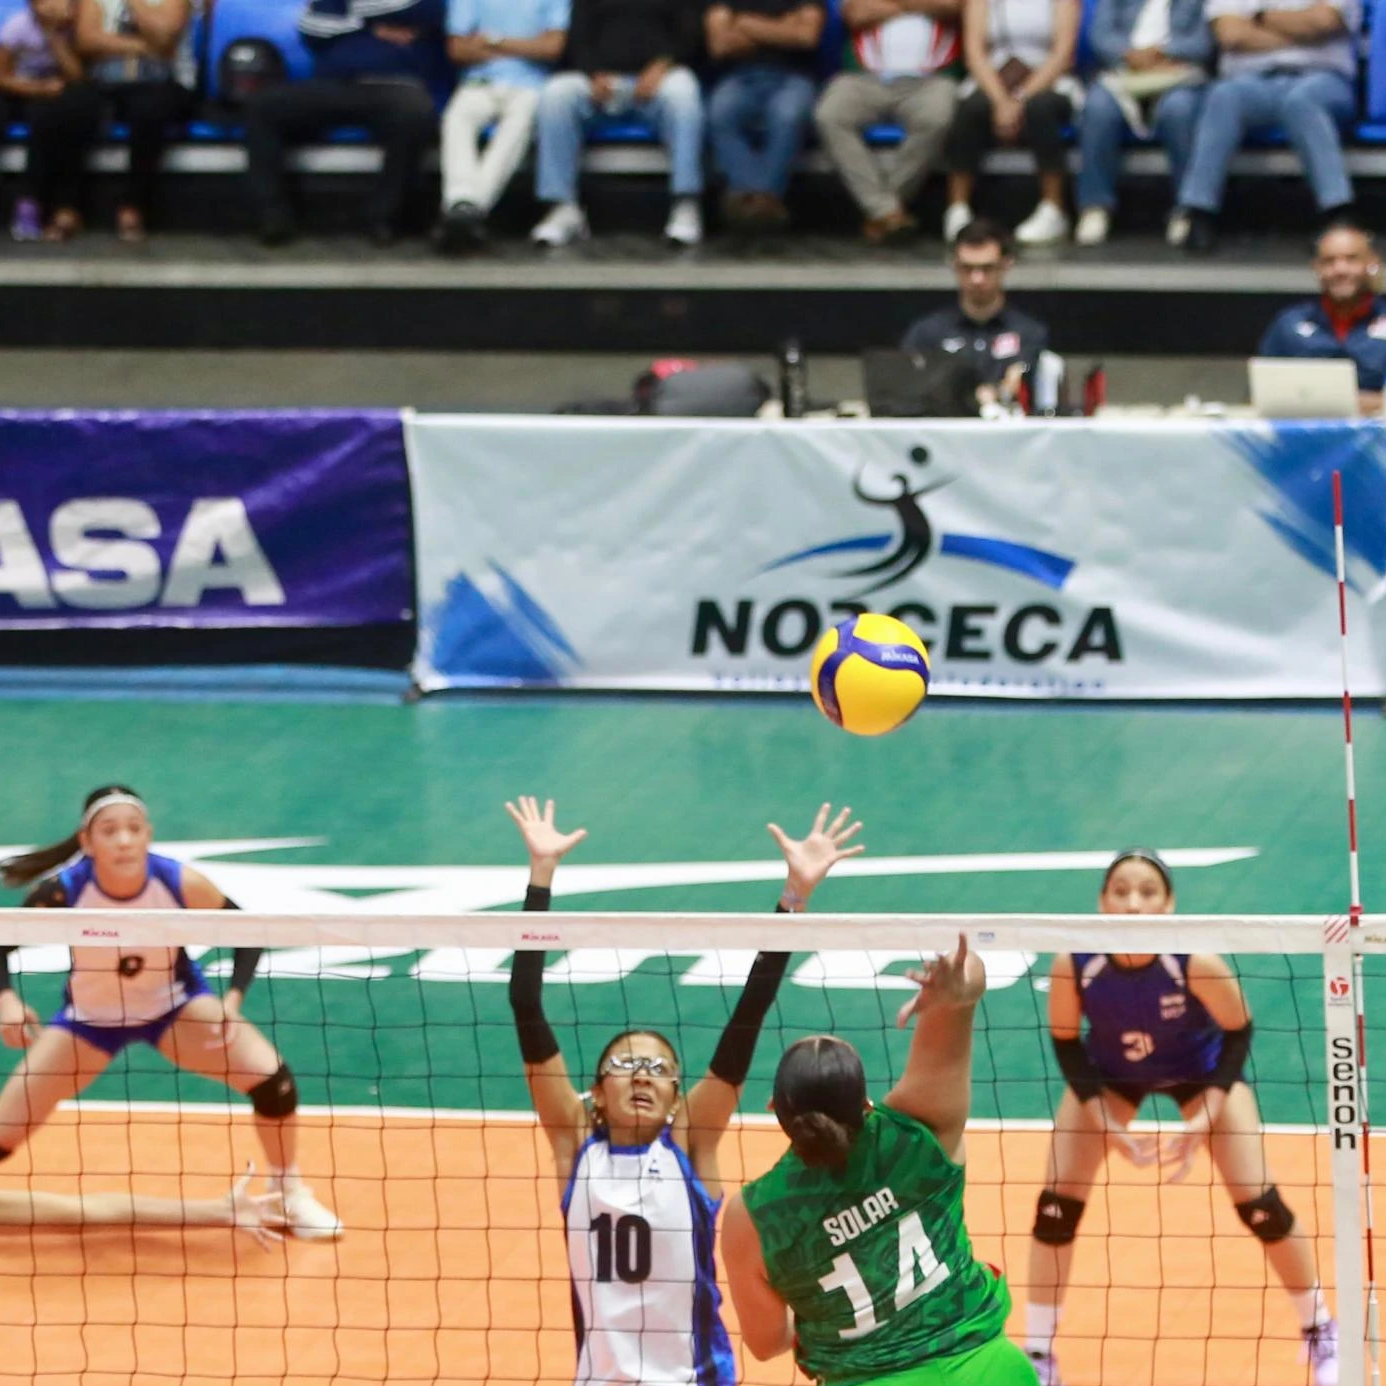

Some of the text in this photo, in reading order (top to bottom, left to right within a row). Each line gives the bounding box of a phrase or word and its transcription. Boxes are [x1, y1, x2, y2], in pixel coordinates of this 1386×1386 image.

[691, 598, 1123, 664] NOCECA
[589, 1212, 652, 1284] 10
[822, 1186, 900, 1248] SOLAR
[817, 1210, 951, 1341] 14
